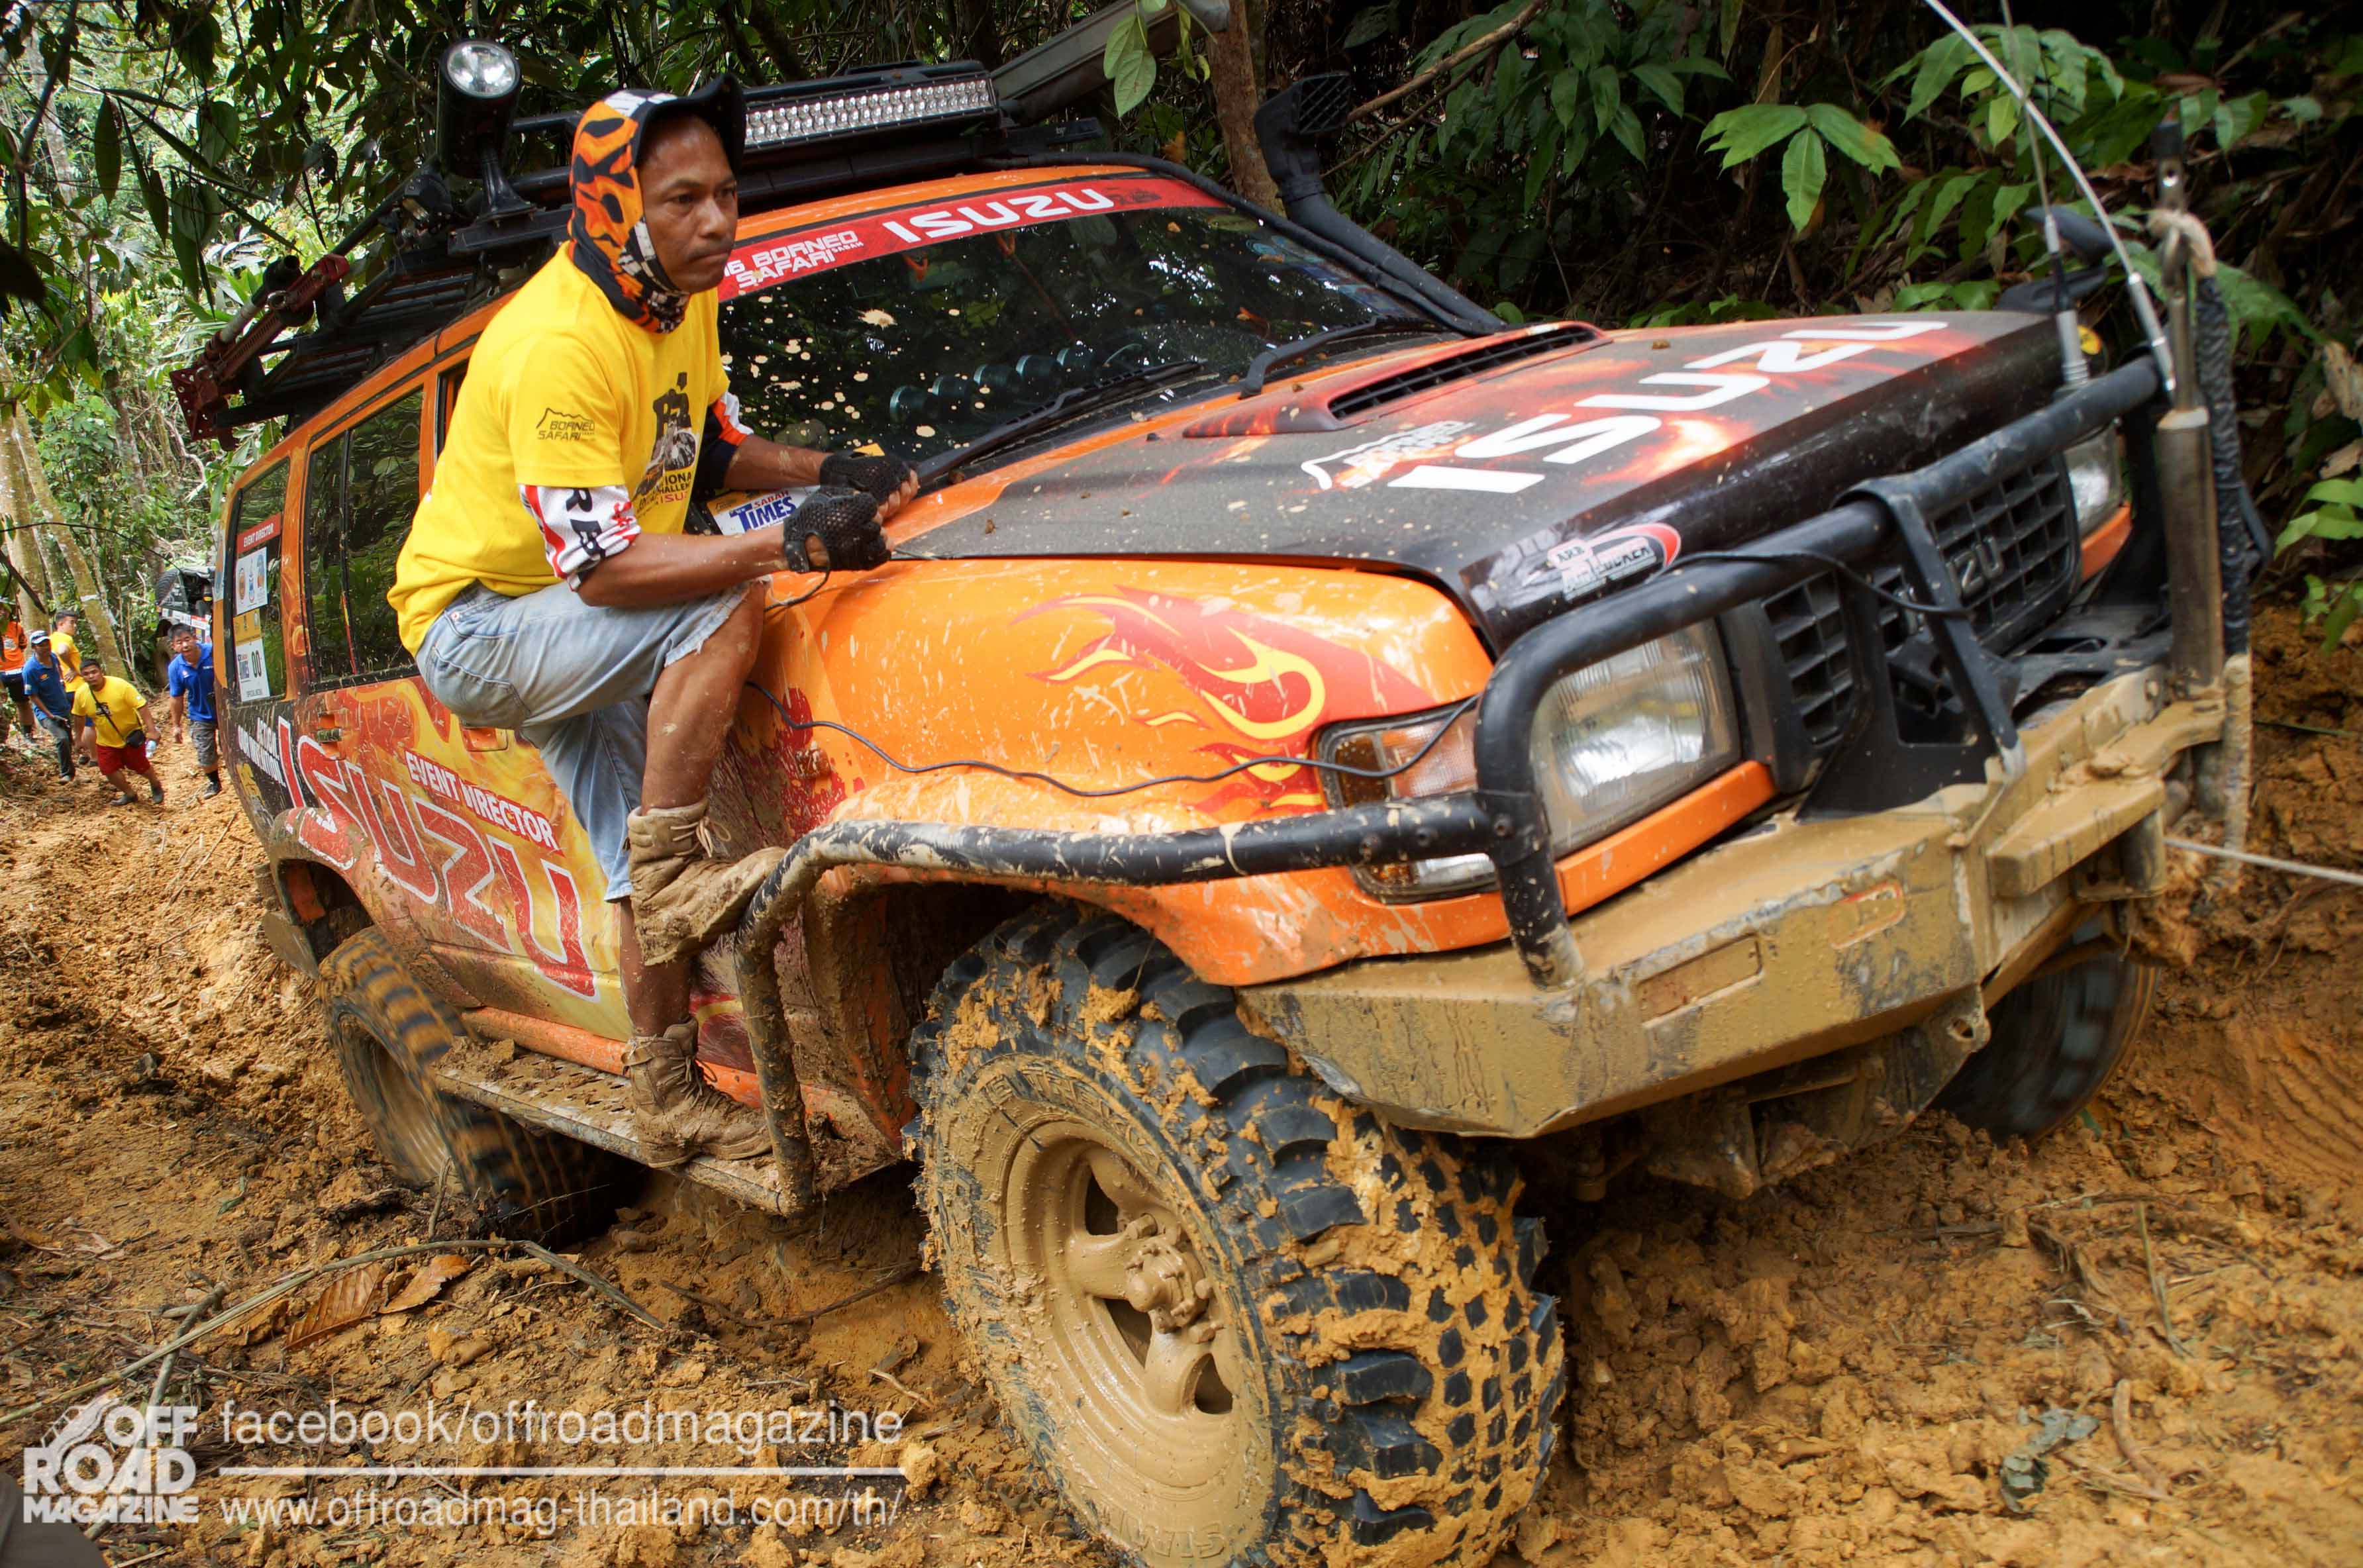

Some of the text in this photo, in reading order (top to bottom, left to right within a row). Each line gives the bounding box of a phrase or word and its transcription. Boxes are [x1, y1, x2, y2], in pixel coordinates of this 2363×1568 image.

[882, 189, 1114, 243] ISUZU
[736, 242, 864, 288] SAFARI SABAH
[752, 230, 858, 268] BORNEO
[550, 420, 595, 431] BORNEO
[1387, 321, 1949, 493] ISUZU
[538, 430, 581, 440] SAFARI
[729, 497, 796, 532] TIMES
[754, 490, 790, 508] SABAH
[405, 751, 559, 851] EVENT DIRECTOR
[278, 716, 601, 1003] ISUZU
